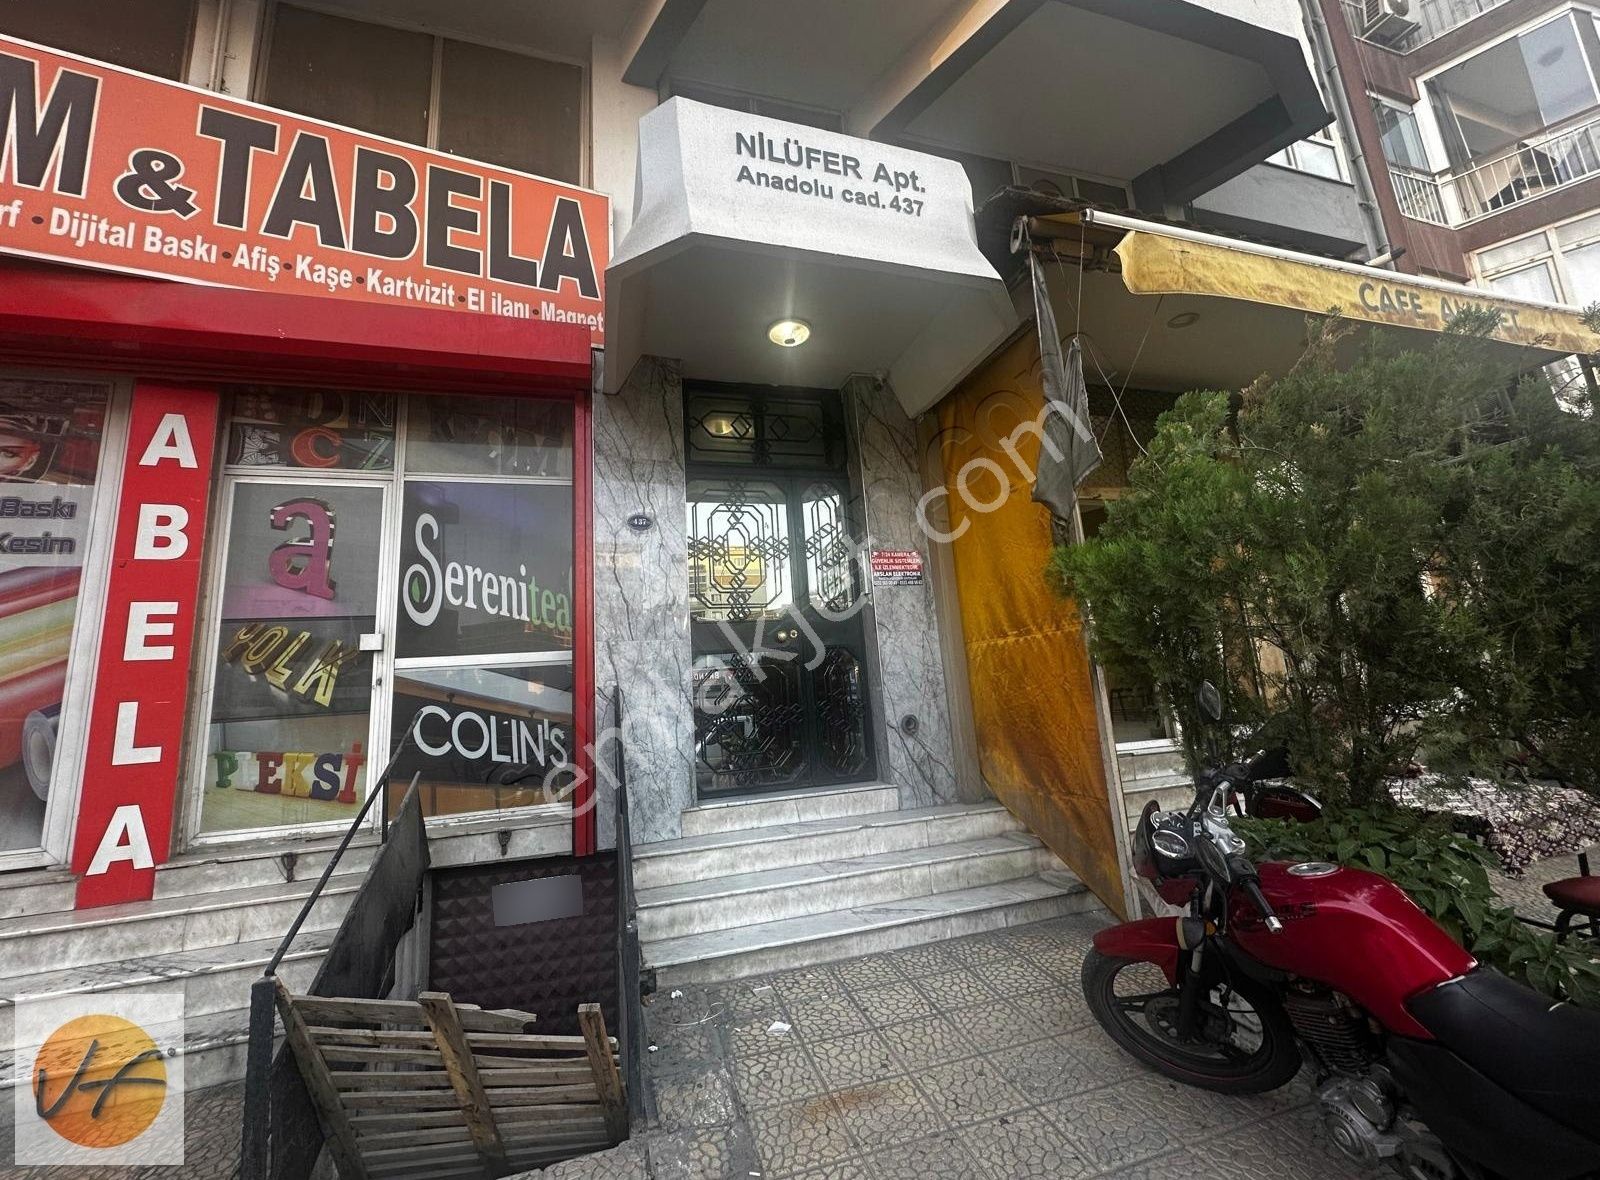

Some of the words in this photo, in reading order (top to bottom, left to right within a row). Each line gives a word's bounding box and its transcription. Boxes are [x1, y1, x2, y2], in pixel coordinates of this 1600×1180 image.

[0, 50, 102, 199] M
[113, 148, 201, 219] &
[197, 103, 603, 301] TABELA
[735, 131, 863, 180] NİLÜFER
[872, 162, 927, 193] Apt.
[736, 165, 835, 200] Anadolu
[49, 207, 136, 248] Dijital
[143, 225, 218, 264] Baskı
[232, 243, 281, 282] Afiş
[295, 254, 353, 292] Kaşe
[366, 267, 456, 307] Kartvizit
[467, 287, 486, 312] El
[1358, 281, 1427, 321] CAFE
[0, 496, 77, 519] Baskı
[85, 412, 199, 877] ABELA
[413, 704, 570, 770] COLIN'S
